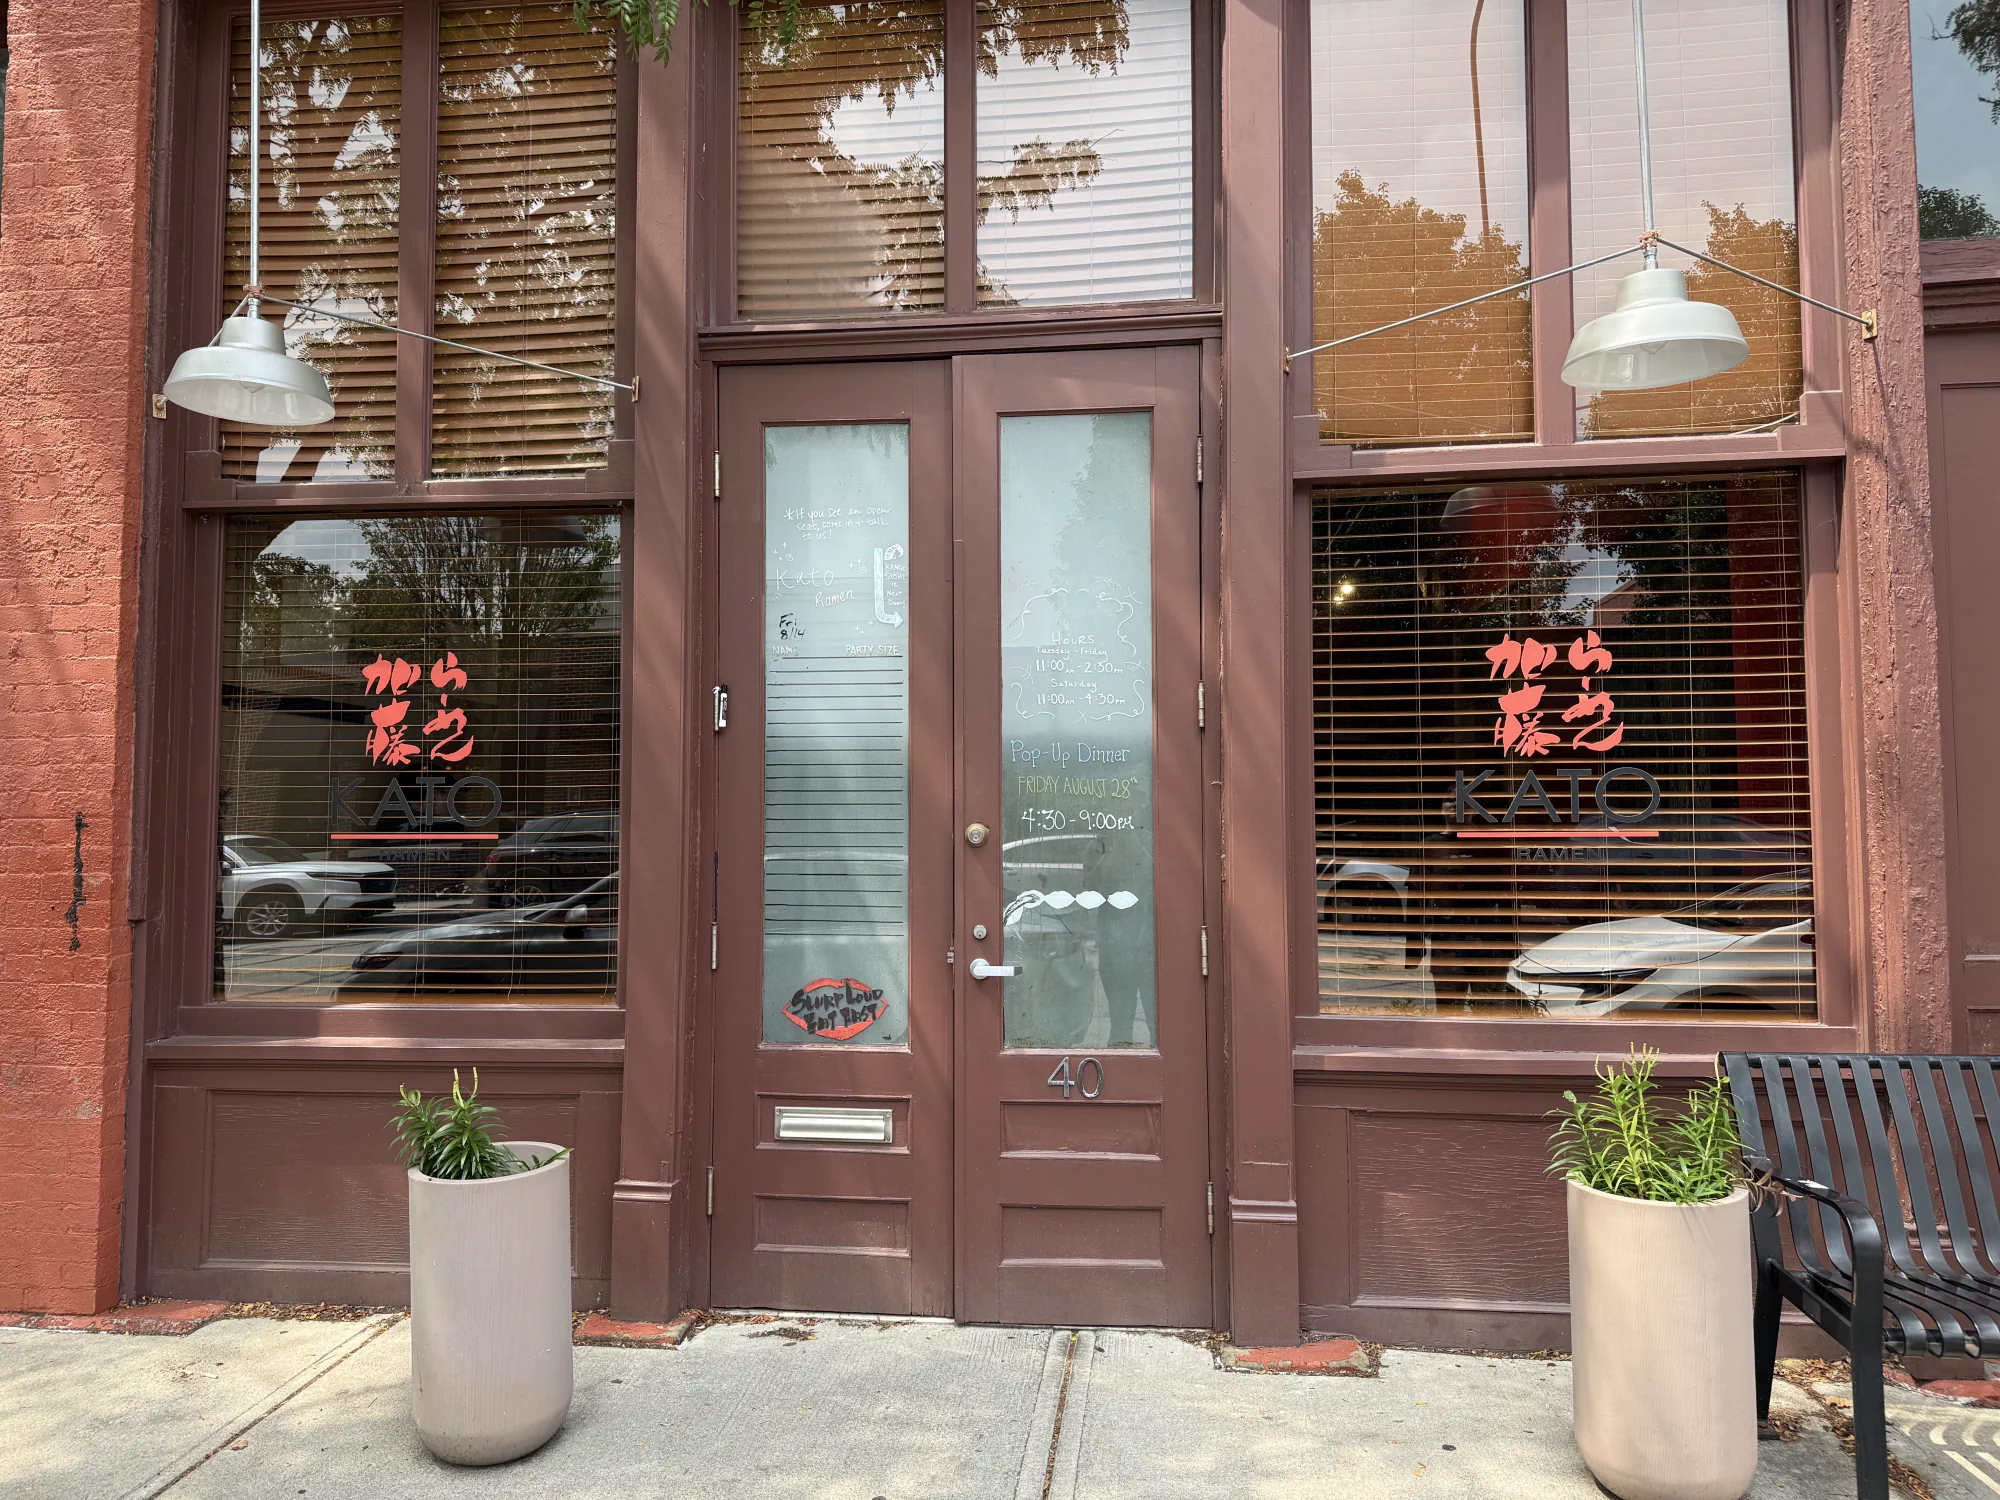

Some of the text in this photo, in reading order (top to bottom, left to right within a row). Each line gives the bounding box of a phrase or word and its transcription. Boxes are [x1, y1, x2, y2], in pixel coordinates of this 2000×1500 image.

[807, 510, 824, 522] you
[848, 508, 861, 516] an
[866, 507, 891, 516] open
[822, 520, 842, 529] come
[845, 519, 853, 527] in
[801, 529, 832, 540] to us!
[815, 590, 854, 608] Ramen
[779, 613, 798, 628] Fri
[780, 627, 806, 640] 8/14
[772, 645, 799, 657] NAME
[845, 645, 900, 656] PARTY SIZE
[1080, 646, 1108, 662] Friday
[1050, 679, 1097, 693] Saturday
[1010, 740, 1130, 768] Pop-Up Dinner
[1018, 775, 1060, 796] FRIDAY
[1063, 776, 1107, 798] AUGUST
[331, 775, 503, 827] KATO
[1455, 766, 1661, 823] KATO
[1021, 807, 1066, 832] 4:30
[380, 848, 451, 861] RAMEN
[1517, 847, 1601, 861] RAMEN
[791, 982, 883, 1015] SLURP LOUD
[804, 1003, 878, 1034] EAT FAST
[1048, 1056, 1104, 1098] 40
